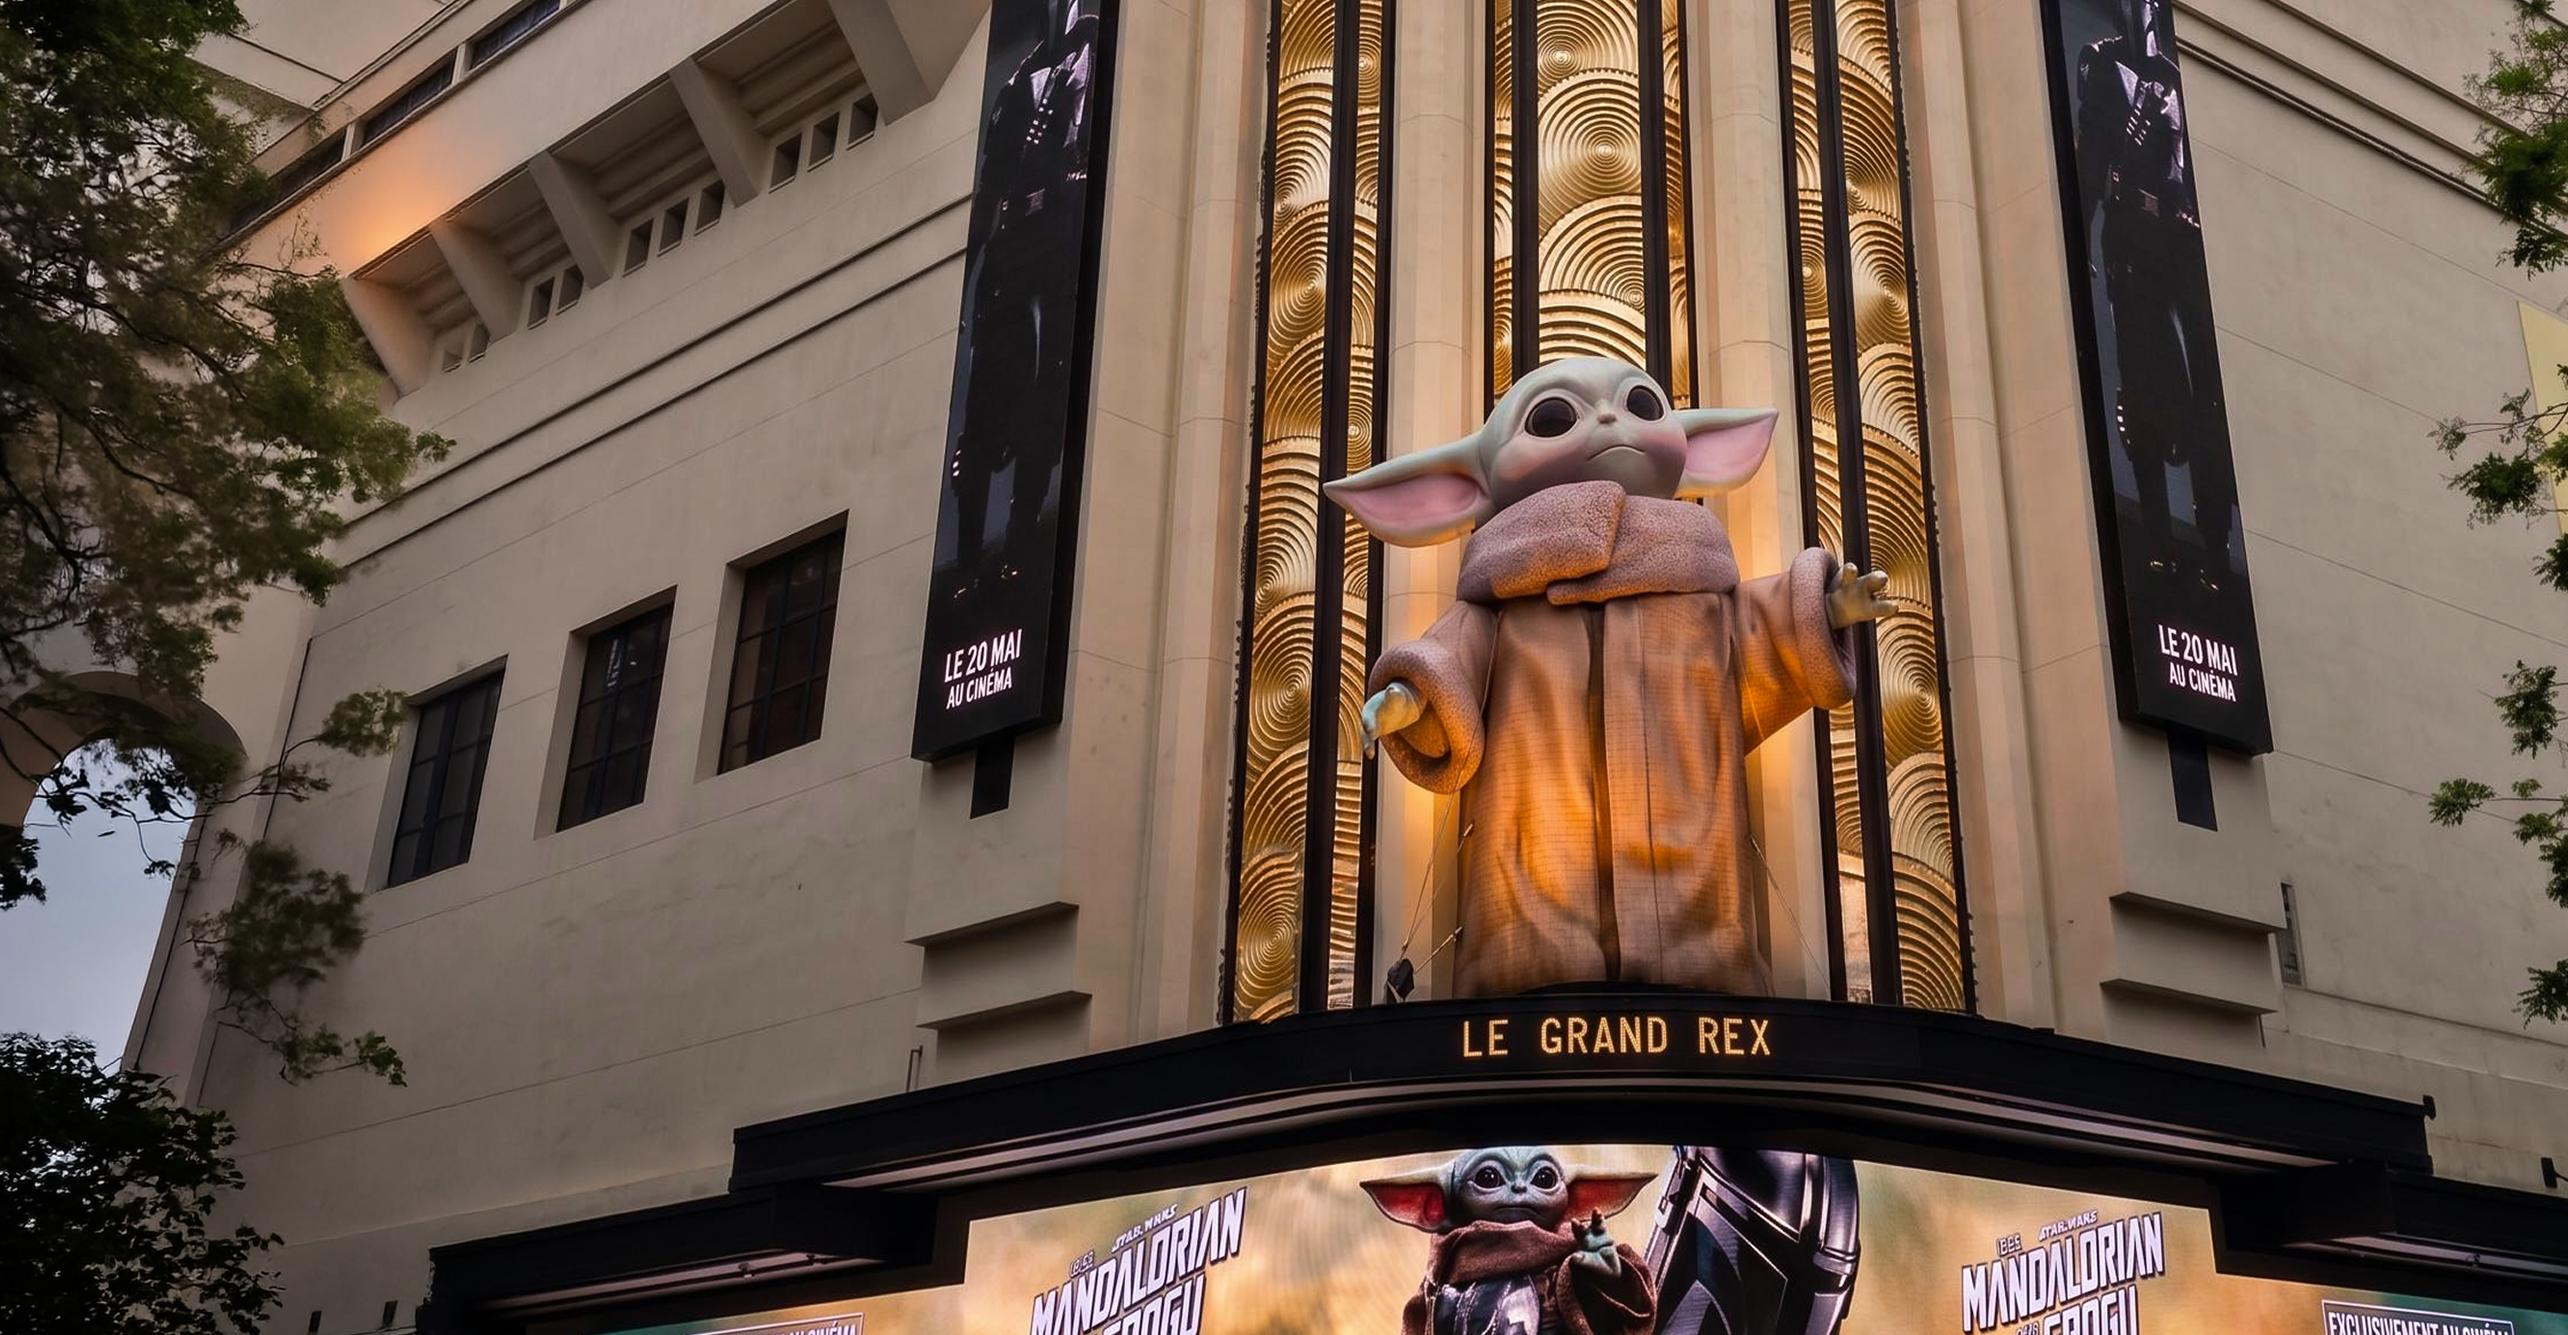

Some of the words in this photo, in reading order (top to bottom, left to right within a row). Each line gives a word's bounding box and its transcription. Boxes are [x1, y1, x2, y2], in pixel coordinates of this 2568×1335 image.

[944, 649, 964, 683] LE
[966, 641, 987, 676] 20
[990, 628, 1022, 667] MAI
[2158, 624, 2180, 658] LE
[2181, 632, 2203, 665] 20
[2205, 638, 2238, 676] MAI
[946, 682, 965, 710] AU
[966, 667, 1012, 703] CINÉMA
[2169, 661, 2186, 688] AU
[2188, 669, 2237, 702] CINÉMA
[1463, 1019, 1509, 1057] LE
[1541, 1017, 1668, 1054] GRAND
[1699, 1017, 1770, 1055] REX
[1030, 1187, 1247, 1335] MANDALORIAN
[1962, 1211, 2165, 1333] MANDALORIAN
[1102, 1272, 1206, 1335] OGU
